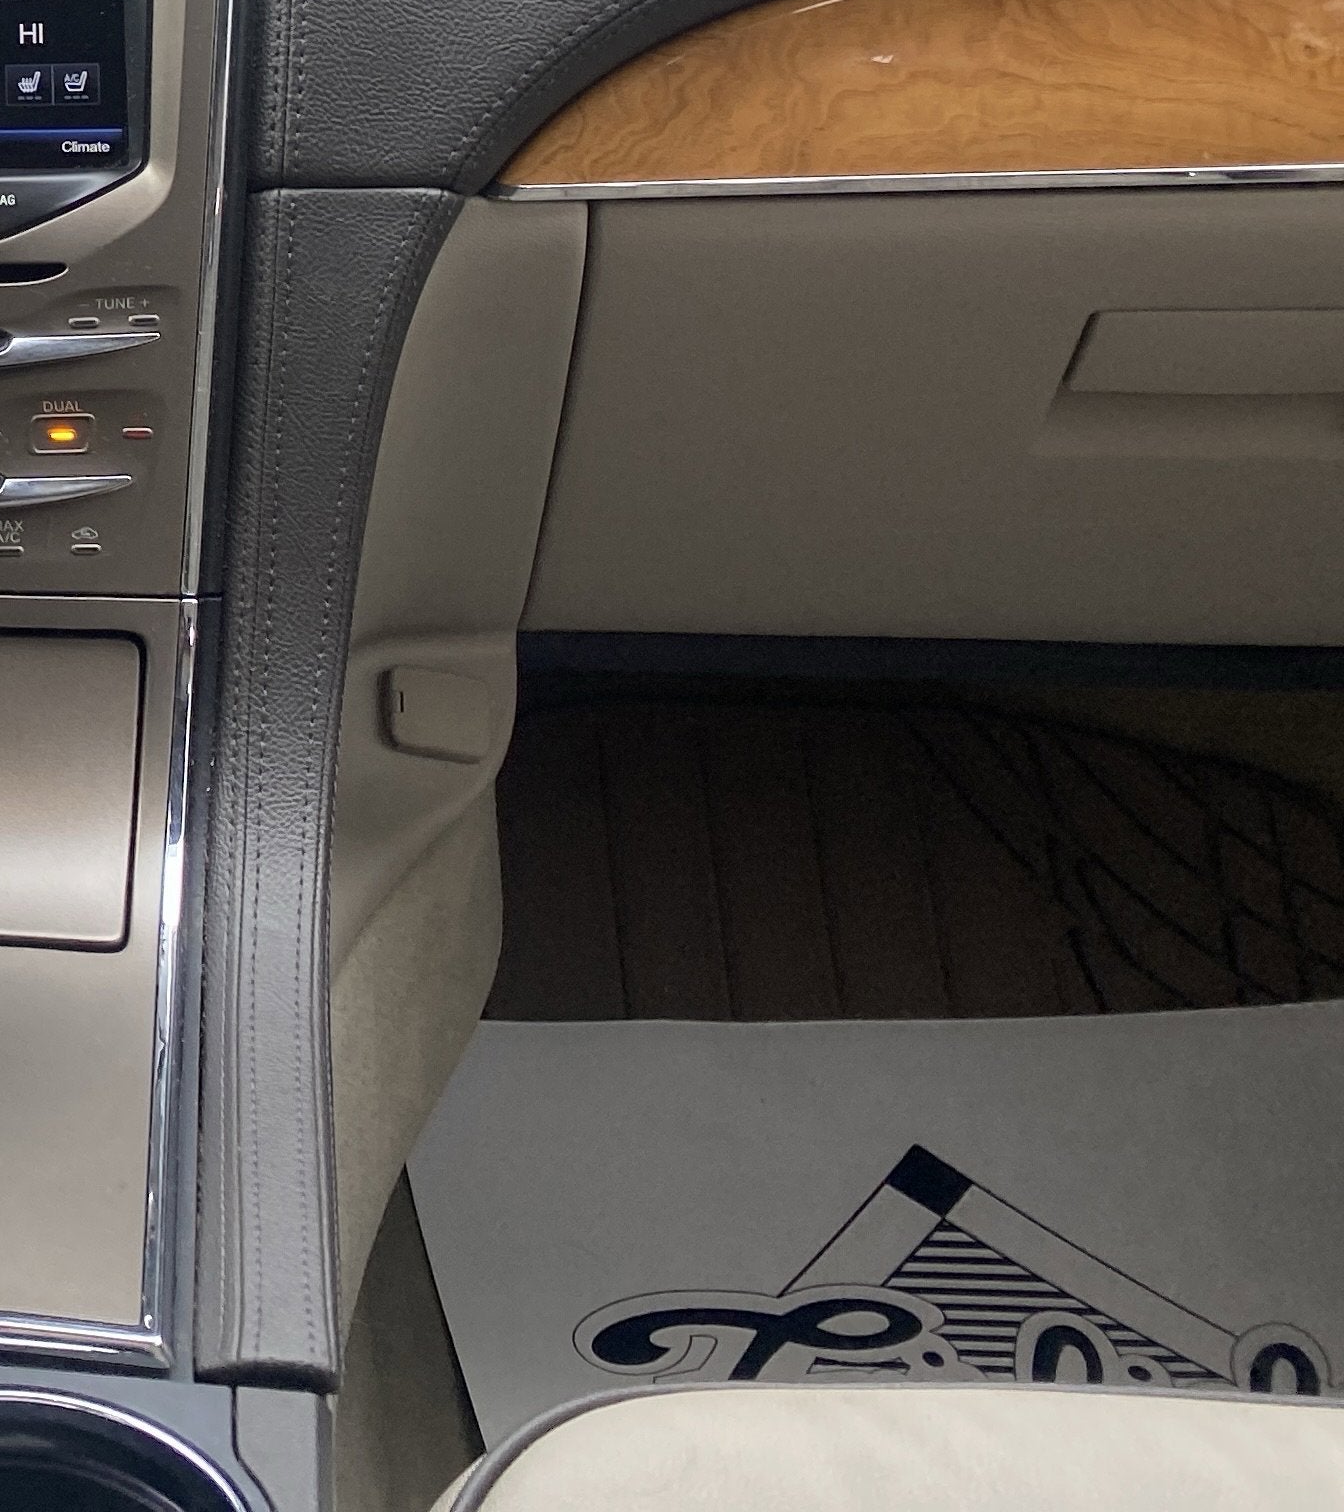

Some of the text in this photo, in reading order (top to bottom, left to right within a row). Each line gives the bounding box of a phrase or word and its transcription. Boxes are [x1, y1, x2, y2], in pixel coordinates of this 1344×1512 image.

[18, 23, 44, 45] HI
[61, 140, 110, 153] Climate
[96, 298, 135, 310] TUNE
[42, 400, 82, 413] DUAL
